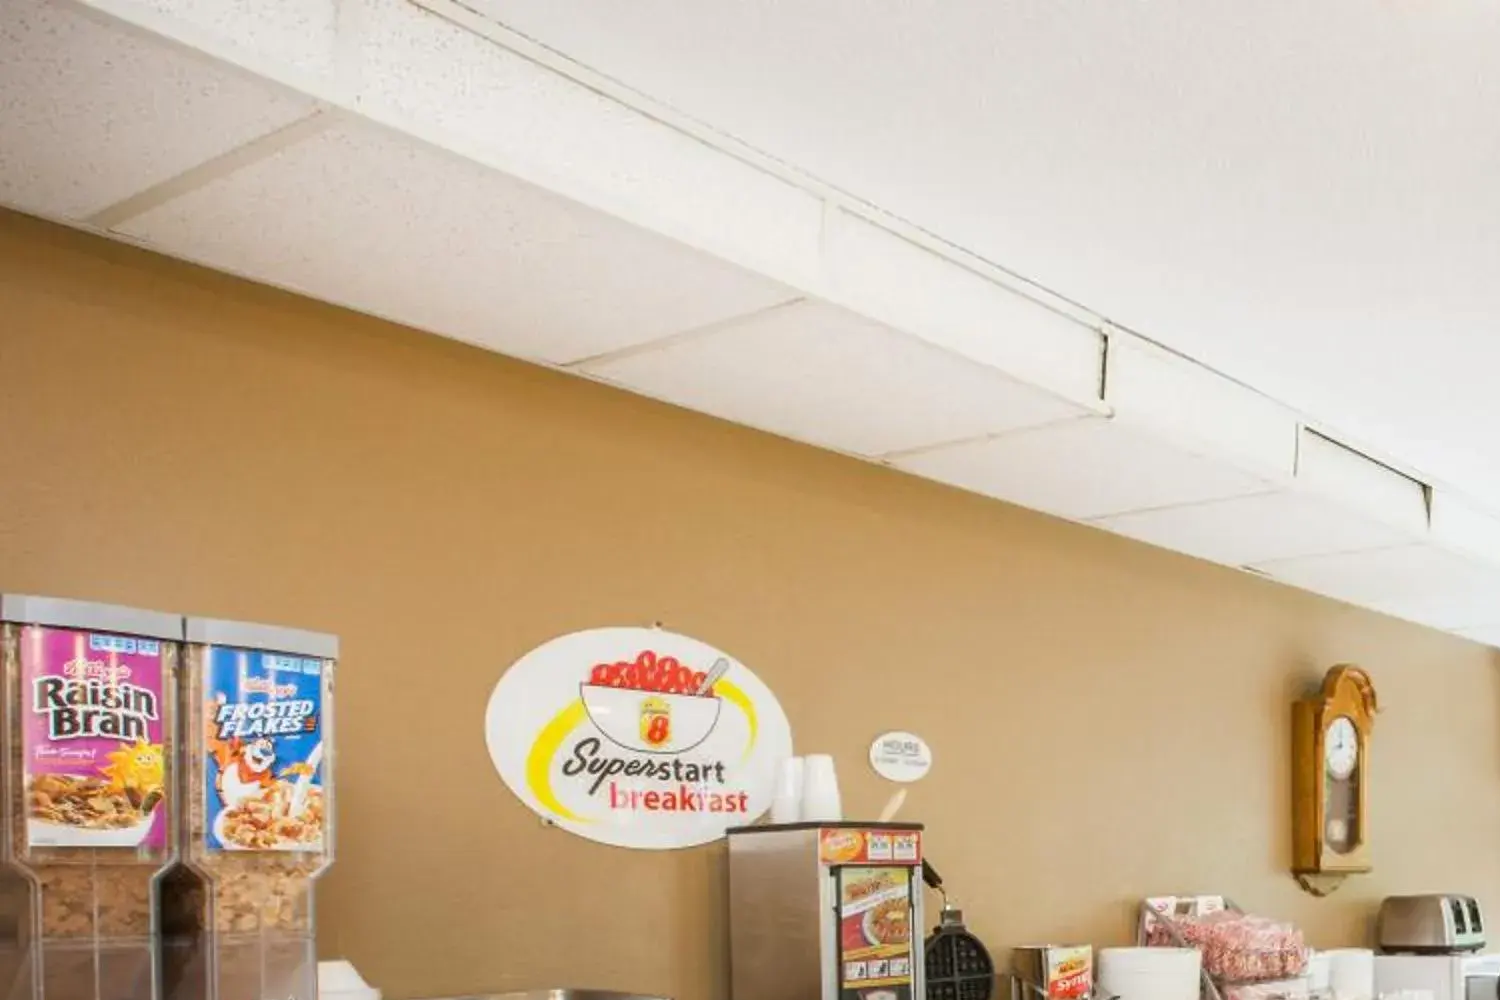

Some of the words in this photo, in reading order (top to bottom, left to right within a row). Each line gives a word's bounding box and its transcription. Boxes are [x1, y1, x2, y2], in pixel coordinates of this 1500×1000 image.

[34, 676, 157, 719] Raisin
[217, 701, 314, 722] FROSTED
[50, 708, 149, 741] Bran
[219, 718, 302, 737] FLAKES
[562, 737, 726, 796] Superstart
